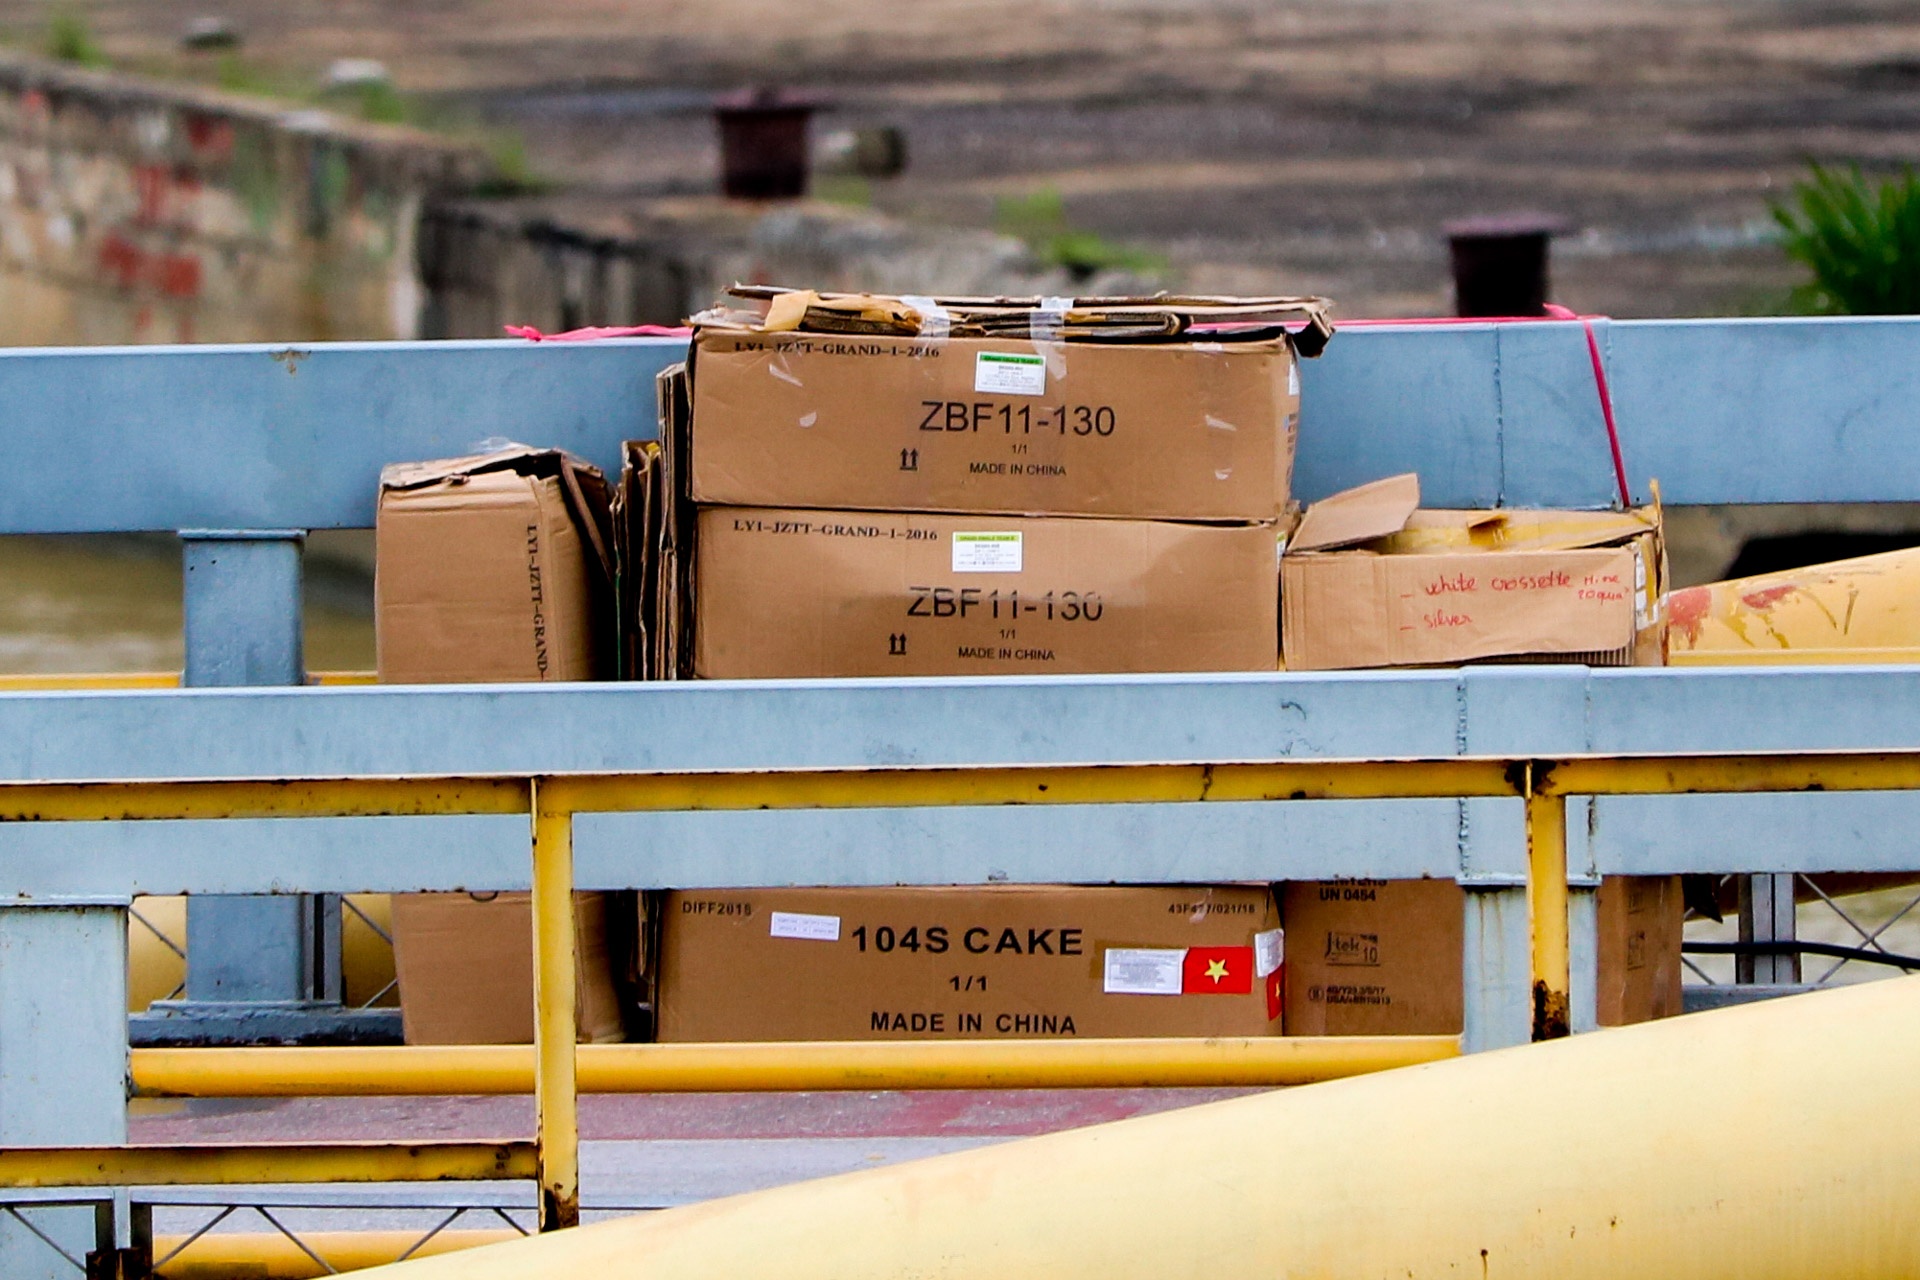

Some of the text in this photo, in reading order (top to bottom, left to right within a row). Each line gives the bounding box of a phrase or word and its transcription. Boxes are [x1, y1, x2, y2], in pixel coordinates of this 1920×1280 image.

[919, 401, 1115, 436] ZBF11-130
[1011, 444, 1029, 454] 1/1
[969, 462, 1066, 476] MADE IN CHINA
[1425, 572, 1478, 596] white
[907, 586, 1103, 621] ZBF11-130
[1424, 609, 1473, 628] silver
[999, 629, 1016, 639] 1/1
[958, 647, 1055, 660] MADE IN CHINA
[1319, 888, 1340, 900] UN
[852, 926, 949, 953] 104S
[964, 927, 1083, 955] CAKE
[1363, 946, 1378, 963] 10
[949, 976, 987, 991] 1/1
[871, 1012, 1076, 1034] MADE IN CHINA
